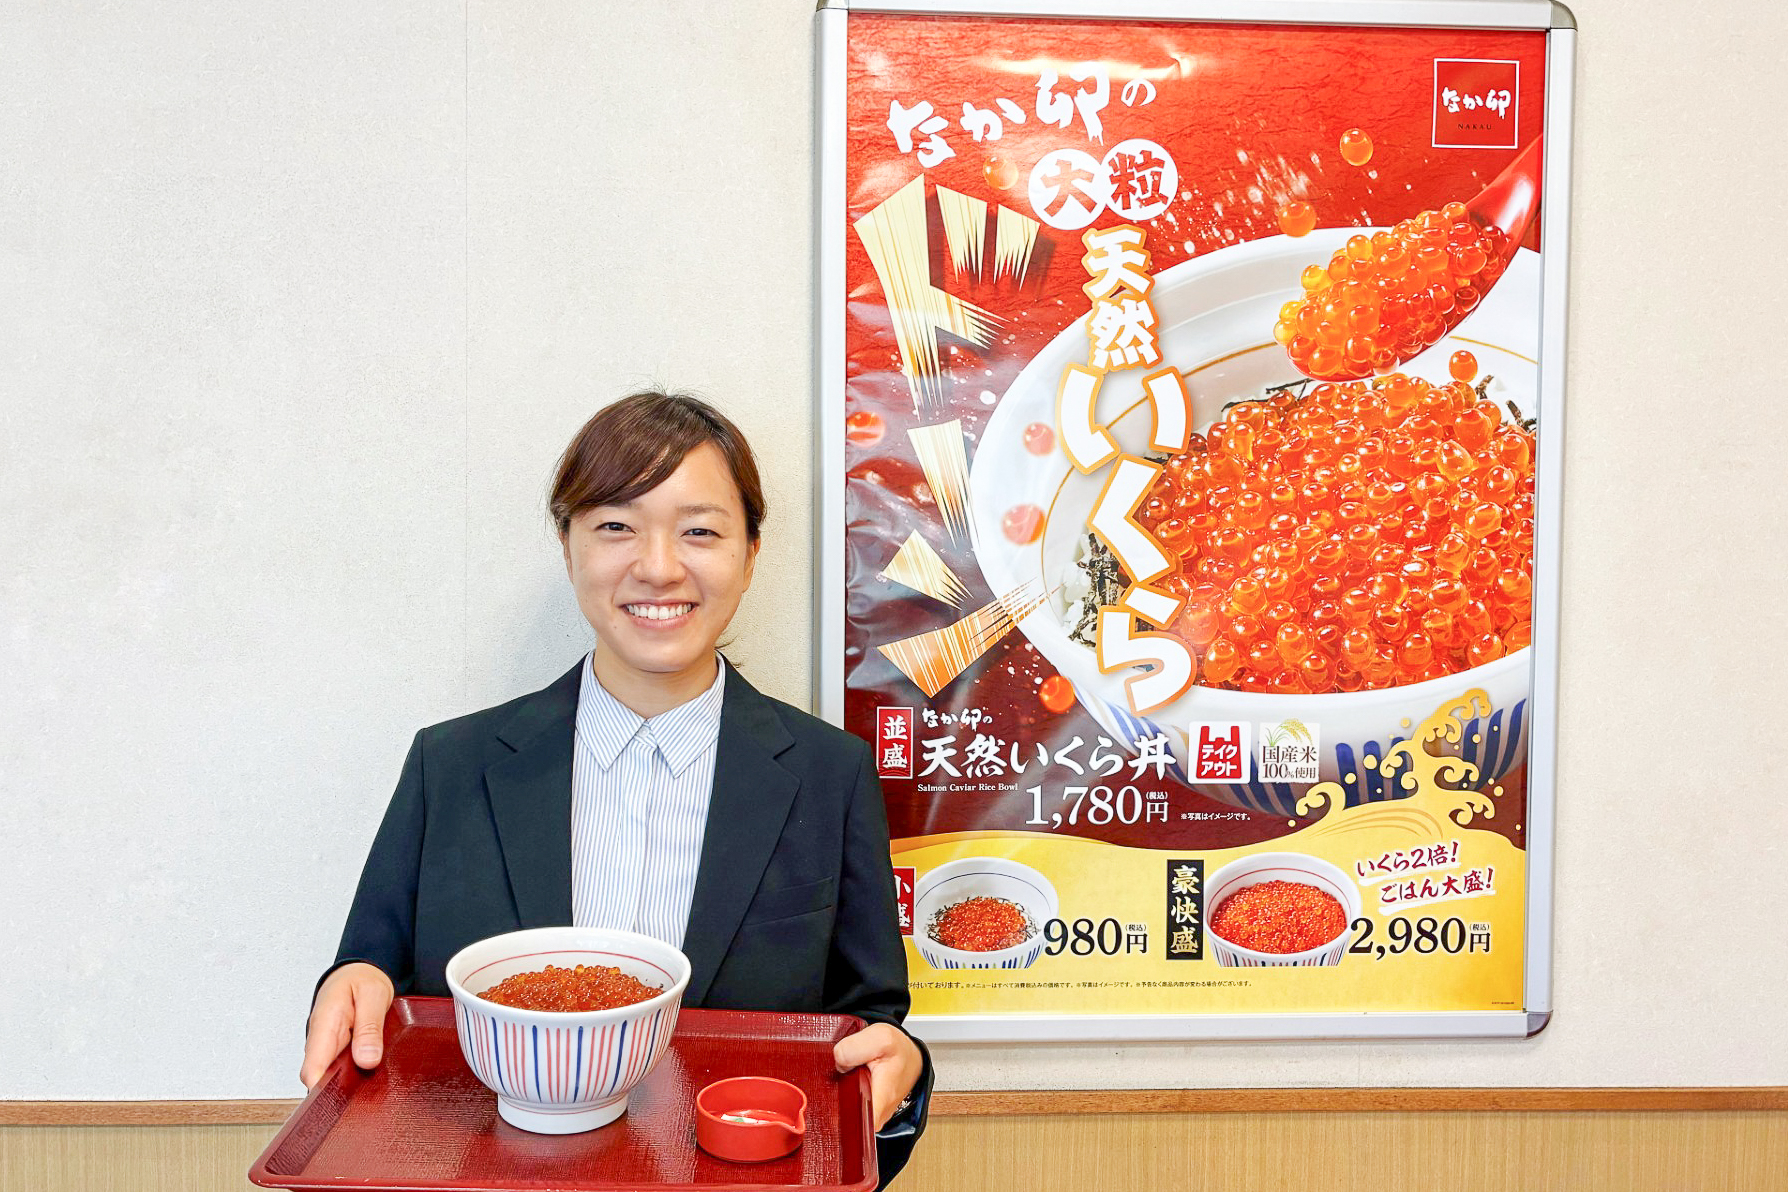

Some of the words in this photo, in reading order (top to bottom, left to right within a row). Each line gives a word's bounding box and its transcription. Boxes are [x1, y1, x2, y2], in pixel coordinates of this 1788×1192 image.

[886, 62, 1157, 168] なか卯の
[1441, 86, 1511, 119] なか卯
[1039, 149, 1169, 218] 大粒
[1056, 225, 1196, 716] 天然いくら
[922, 707, 993, 732] なか卯の
[882, 714, 908, 769] 並盛
[917, 733, 1177, 781] 天然いくら丼
[1201, 744, 1238, 760] テイク
[1262, 745, 1317, 764] 国産米
[917, 783, 947, 792] Salmon
[949, 783, 976, 792] Caviar
[978, 783, 996, 791] Rice
[998, 782, 1018, 791] Bowl
[1200, 761, 1238, 777] アウト
[1262, 763, 1317, 779] 100%使用
[1356, 841, 1459, 877] いくら2倍!
[1381, 867, 1494, 903] ごはん大盛!
[1170, 864, 1200, 954] 豪快盛
